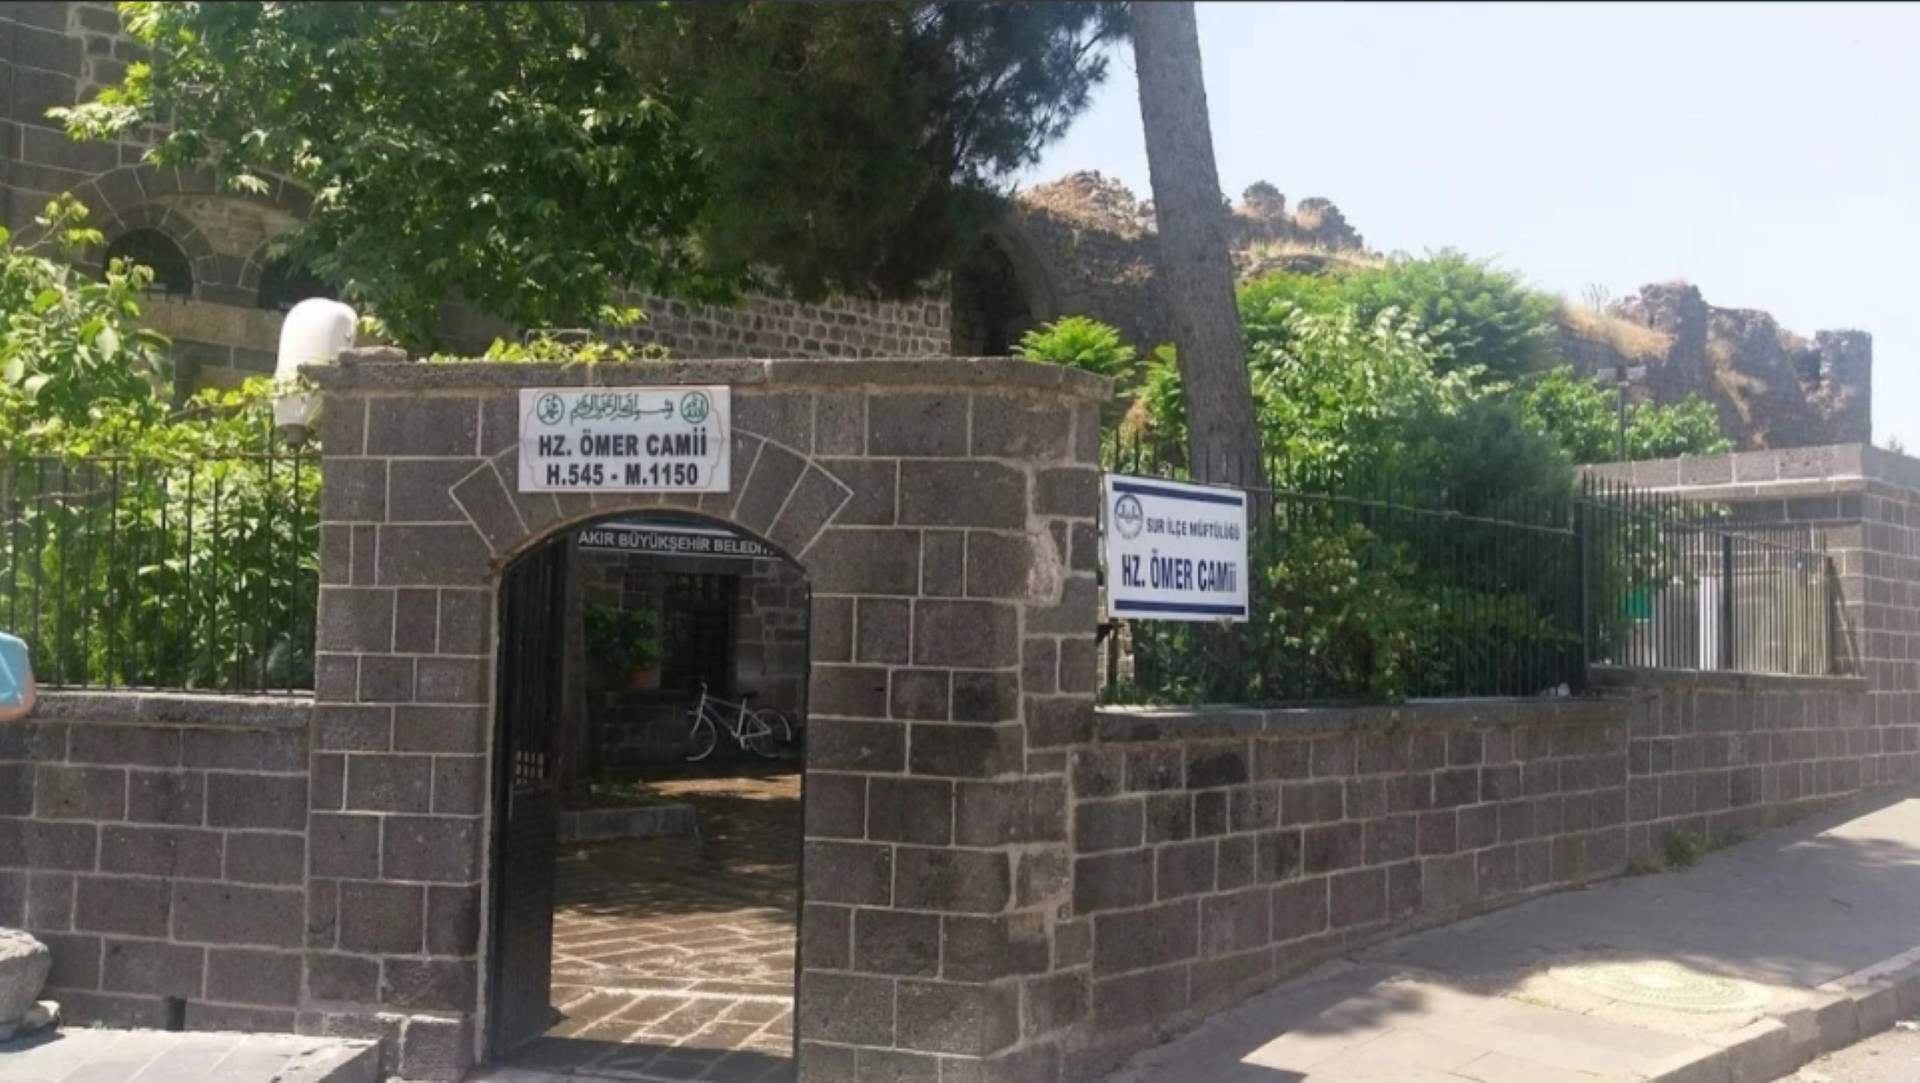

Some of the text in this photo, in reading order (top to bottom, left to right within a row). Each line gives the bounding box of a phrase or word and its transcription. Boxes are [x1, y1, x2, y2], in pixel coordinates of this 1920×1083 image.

[539, 434, 571, 457] HZ.
[580, 429, 638, 456] ÖMER
[547, 464, 604, 486] H.545
[625, 463, 698, 486] M.1150
[1146, 518, 1164, 533] SUR
[1167, 516, 1187, 540] İLÇE
[578, 531, 615, 546] AKIR
[618, 530, 711, 552] BÜYÜKŞEHİR
[1122, 554, 1145, 587] HZ.
[1150, 549, 1192, 590] ÖMER
